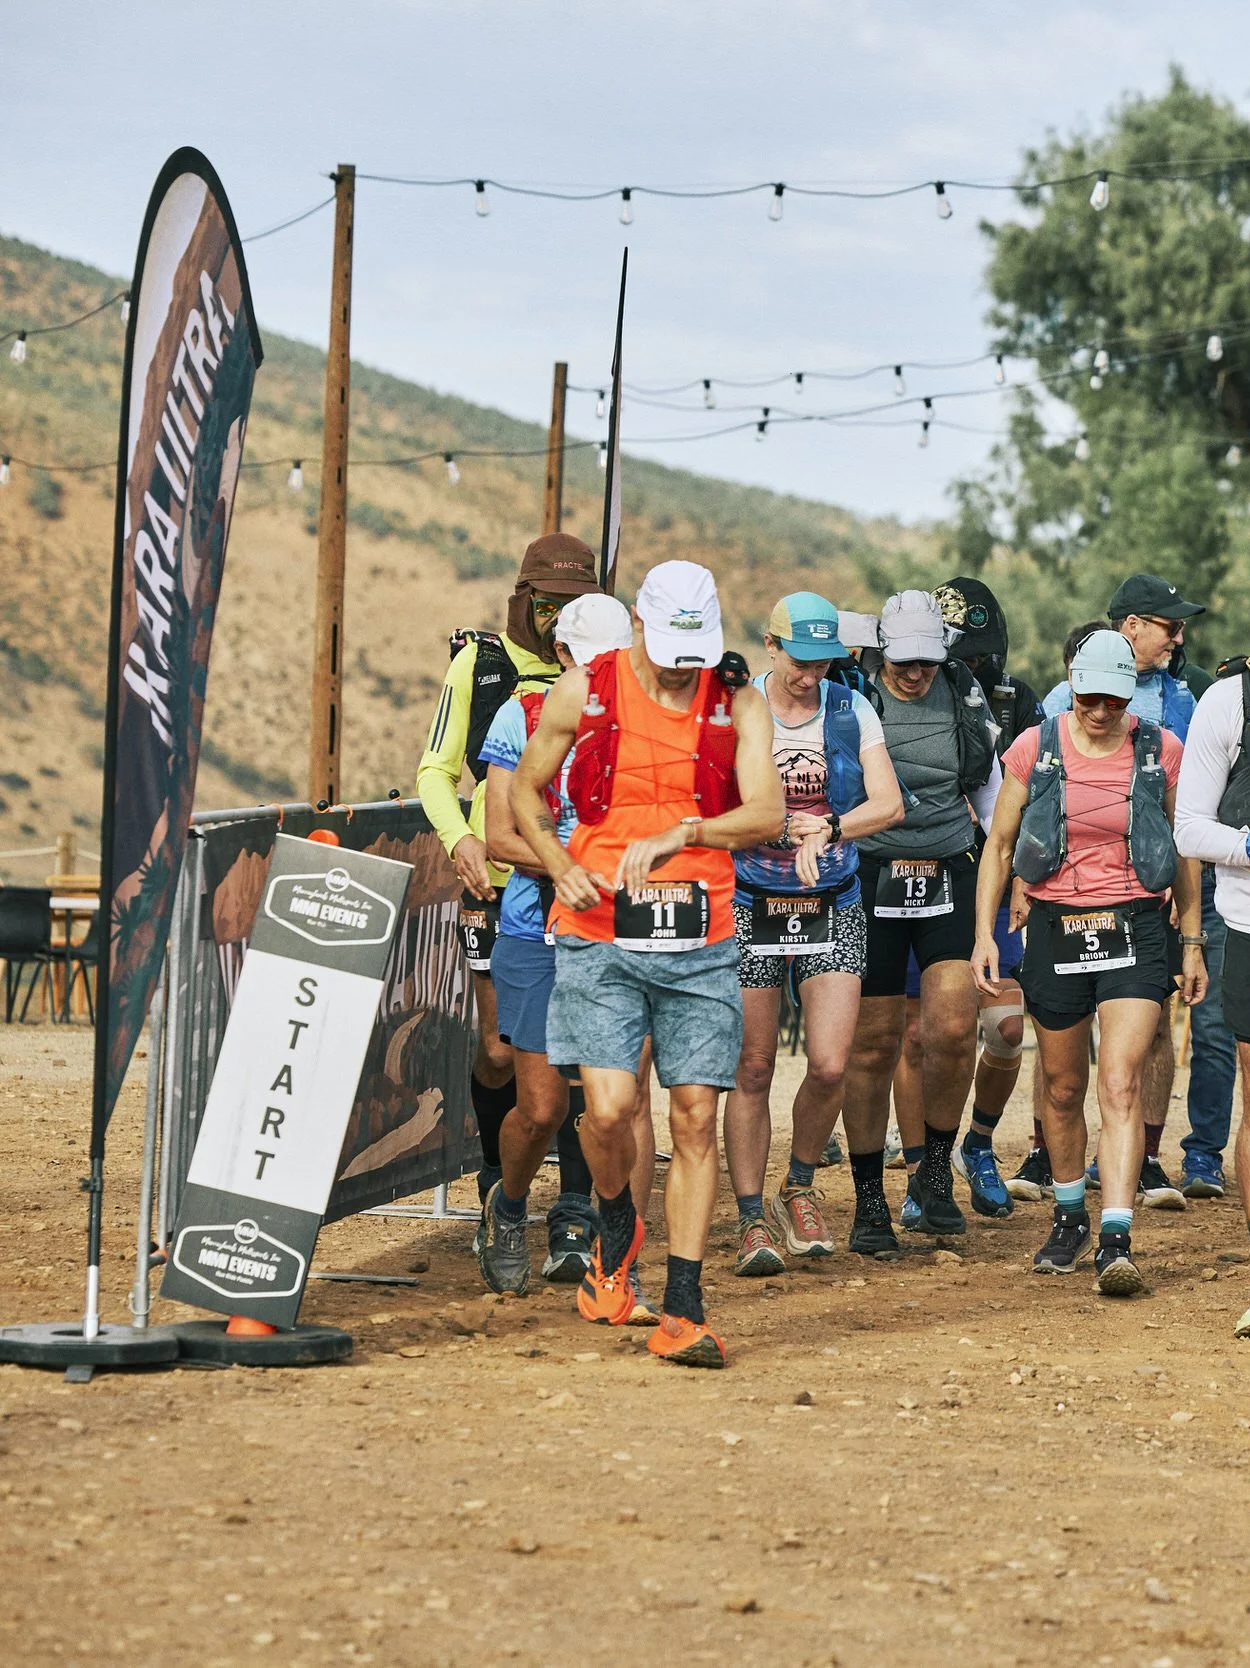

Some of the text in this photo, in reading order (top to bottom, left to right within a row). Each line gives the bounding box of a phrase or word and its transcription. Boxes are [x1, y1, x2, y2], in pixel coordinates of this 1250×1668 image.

[154, 270, 235, 503] ULTRA
[1118, 662, 1133, 670] 2XU
[892, 864, 936, 878] IKARA ULTRA
[661, 887, 692, 904] ULTRA
[904, 876, 926, 898] 13
[290, 898, 368, 928] MMI EVENTS
[651, 902, 675, 928] 11
[768, 902, 819, 916] IKARA ULTRA
[650, 929, 676, 938] JOHN
[787, 913, 802, 934] 6
[1064, 917, 1116, 934] IKARA ULTRA
[464, 926, 478, 948] 16
[1085, 930, 1100, 951] 5
[1080, 951, 1109, 960] BRIONY
[254, 976, 318, 1180] START
[198, 1248, 278, 1281] MMI EVENTS
